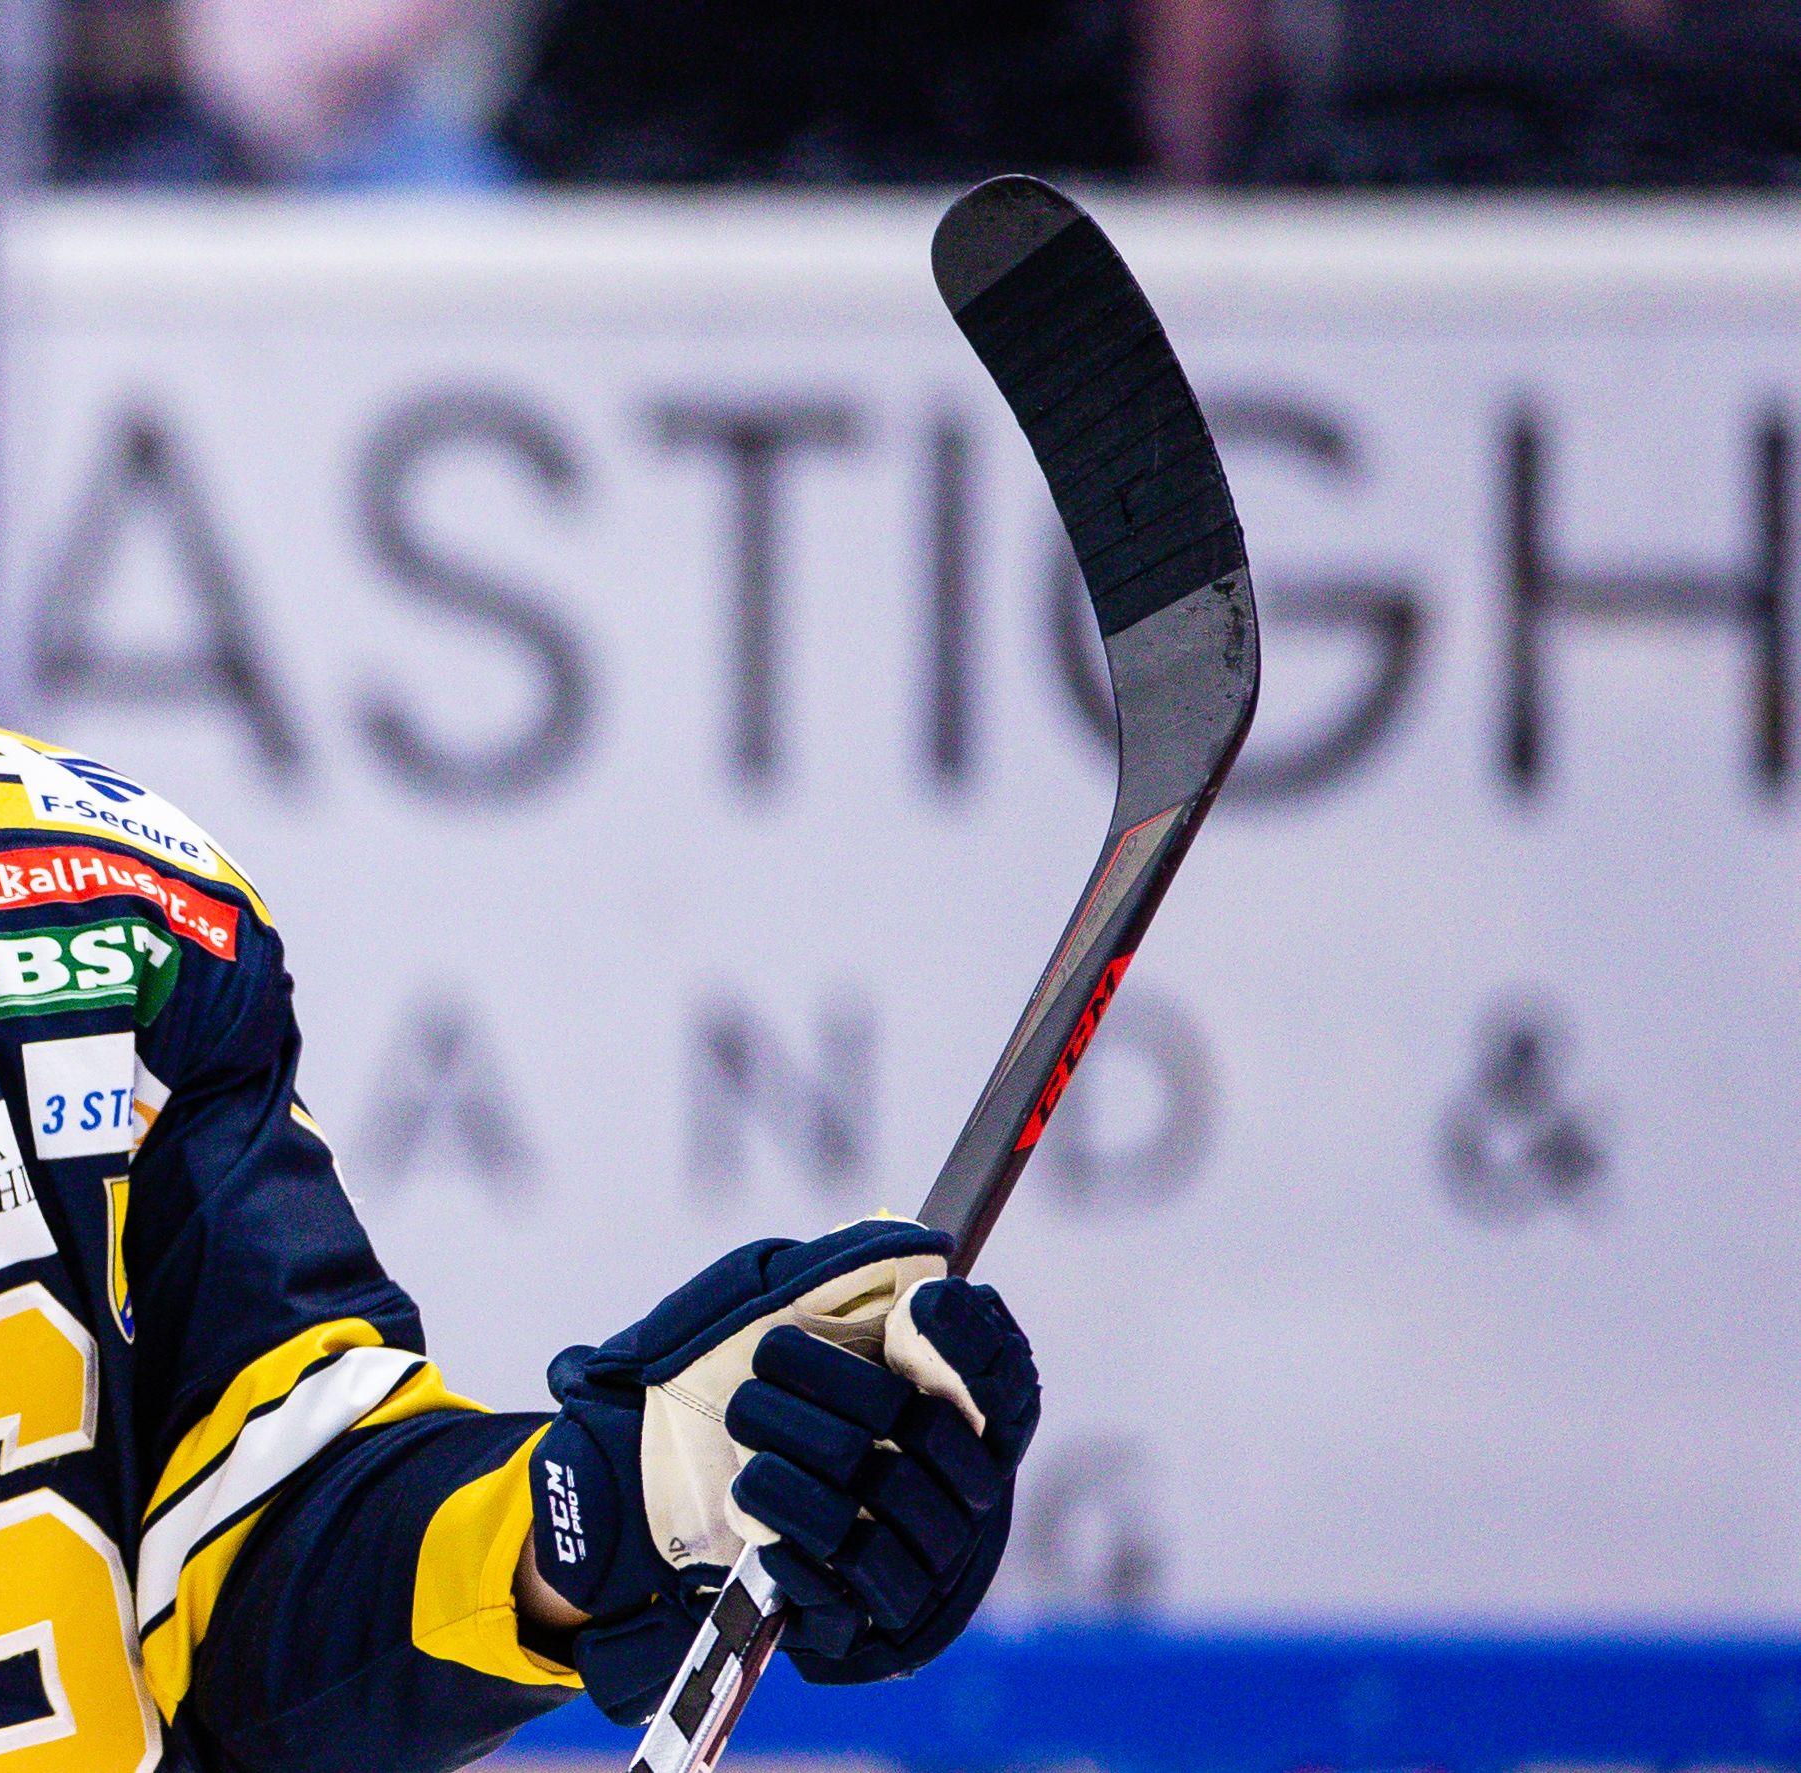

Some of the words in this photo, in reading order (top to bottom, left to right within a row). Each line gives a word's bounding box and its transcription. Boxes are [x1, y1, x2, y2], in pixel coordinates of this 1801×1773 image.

[1037, 968, 1115, 1128] CCM
[42, 1094, 66, 1134] 3
[544, 1459, 578, 1565] CCM
[569, 1491, 584, 1535] PRO
